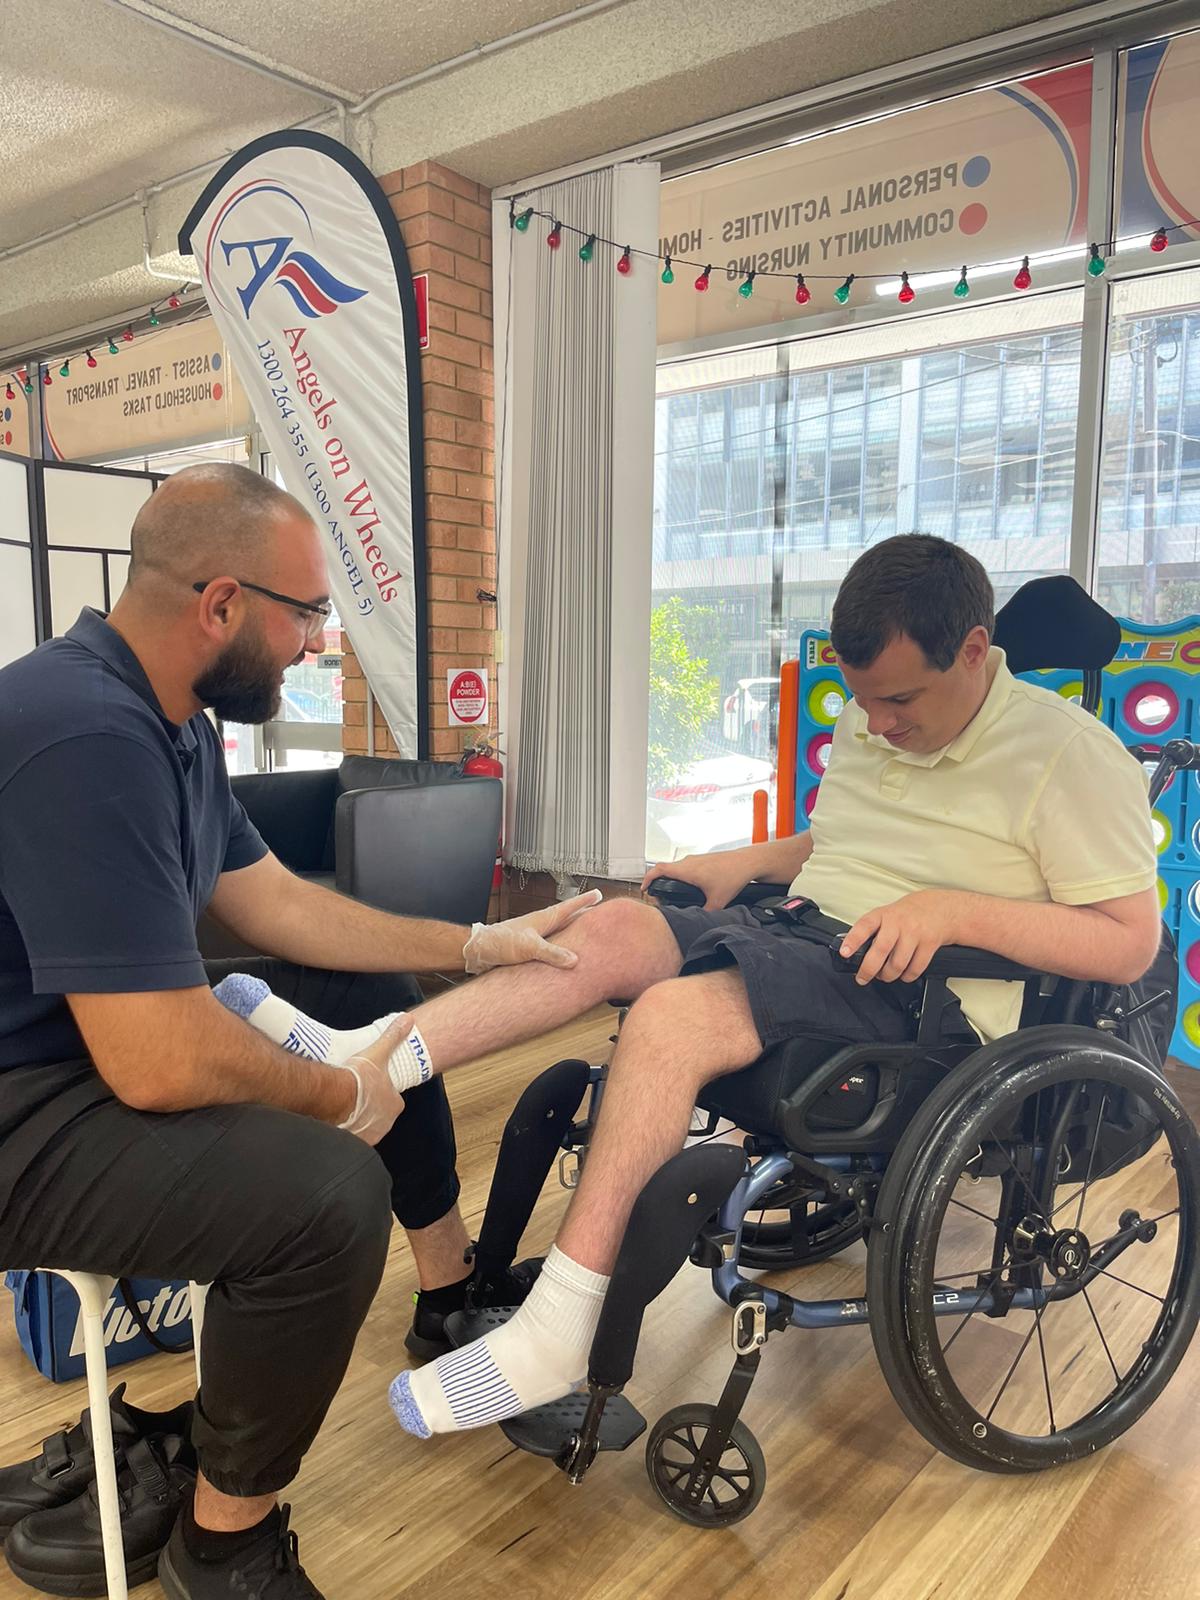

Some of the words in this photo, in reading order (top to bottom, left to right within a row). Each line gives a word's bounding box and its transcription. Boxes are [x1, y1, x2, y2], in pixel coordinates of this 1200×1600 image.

[257, 339, 284, 381] 1300
[271, 385, 295, 419] 264
[287, 421, 309, 457] 355
[304, 462, 331, 514] (1300
[328, 520, 364, 595] ANGEL
[358, 597, 375, 616] 5)
[283, 327, 337, 430] Angels
[325, 437, 351, 480] on
[343, 478, 403, 604] Wheels
